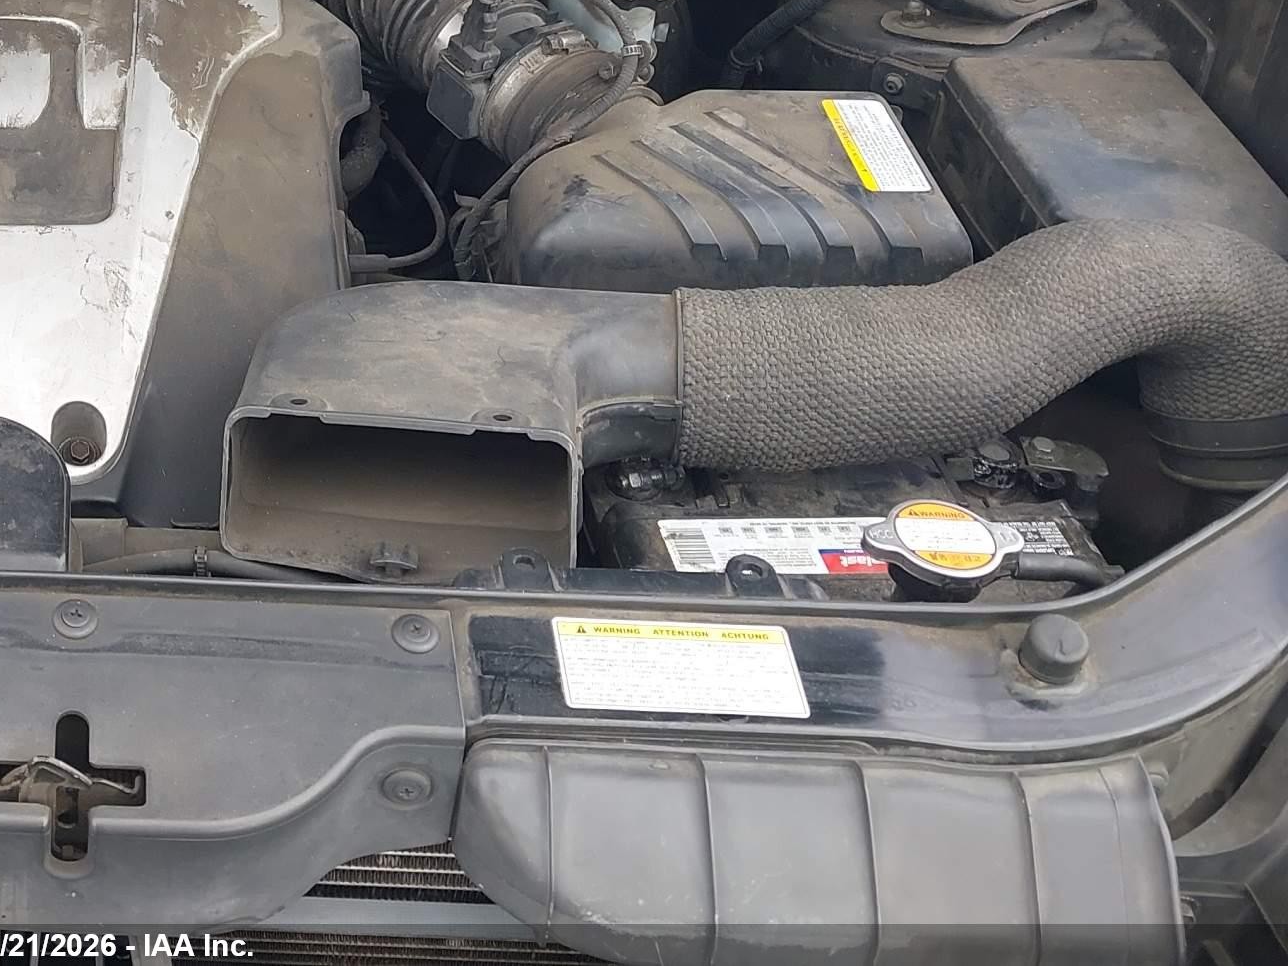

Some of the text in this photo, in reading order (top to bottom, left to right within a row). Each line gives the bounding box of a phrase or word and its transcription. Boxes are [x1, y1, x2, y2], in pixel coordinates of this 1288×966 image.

[918, 509, 966, 519] WARNING
[594, 626, 770, 641] WARNING ATTENTION ACHTUNG
